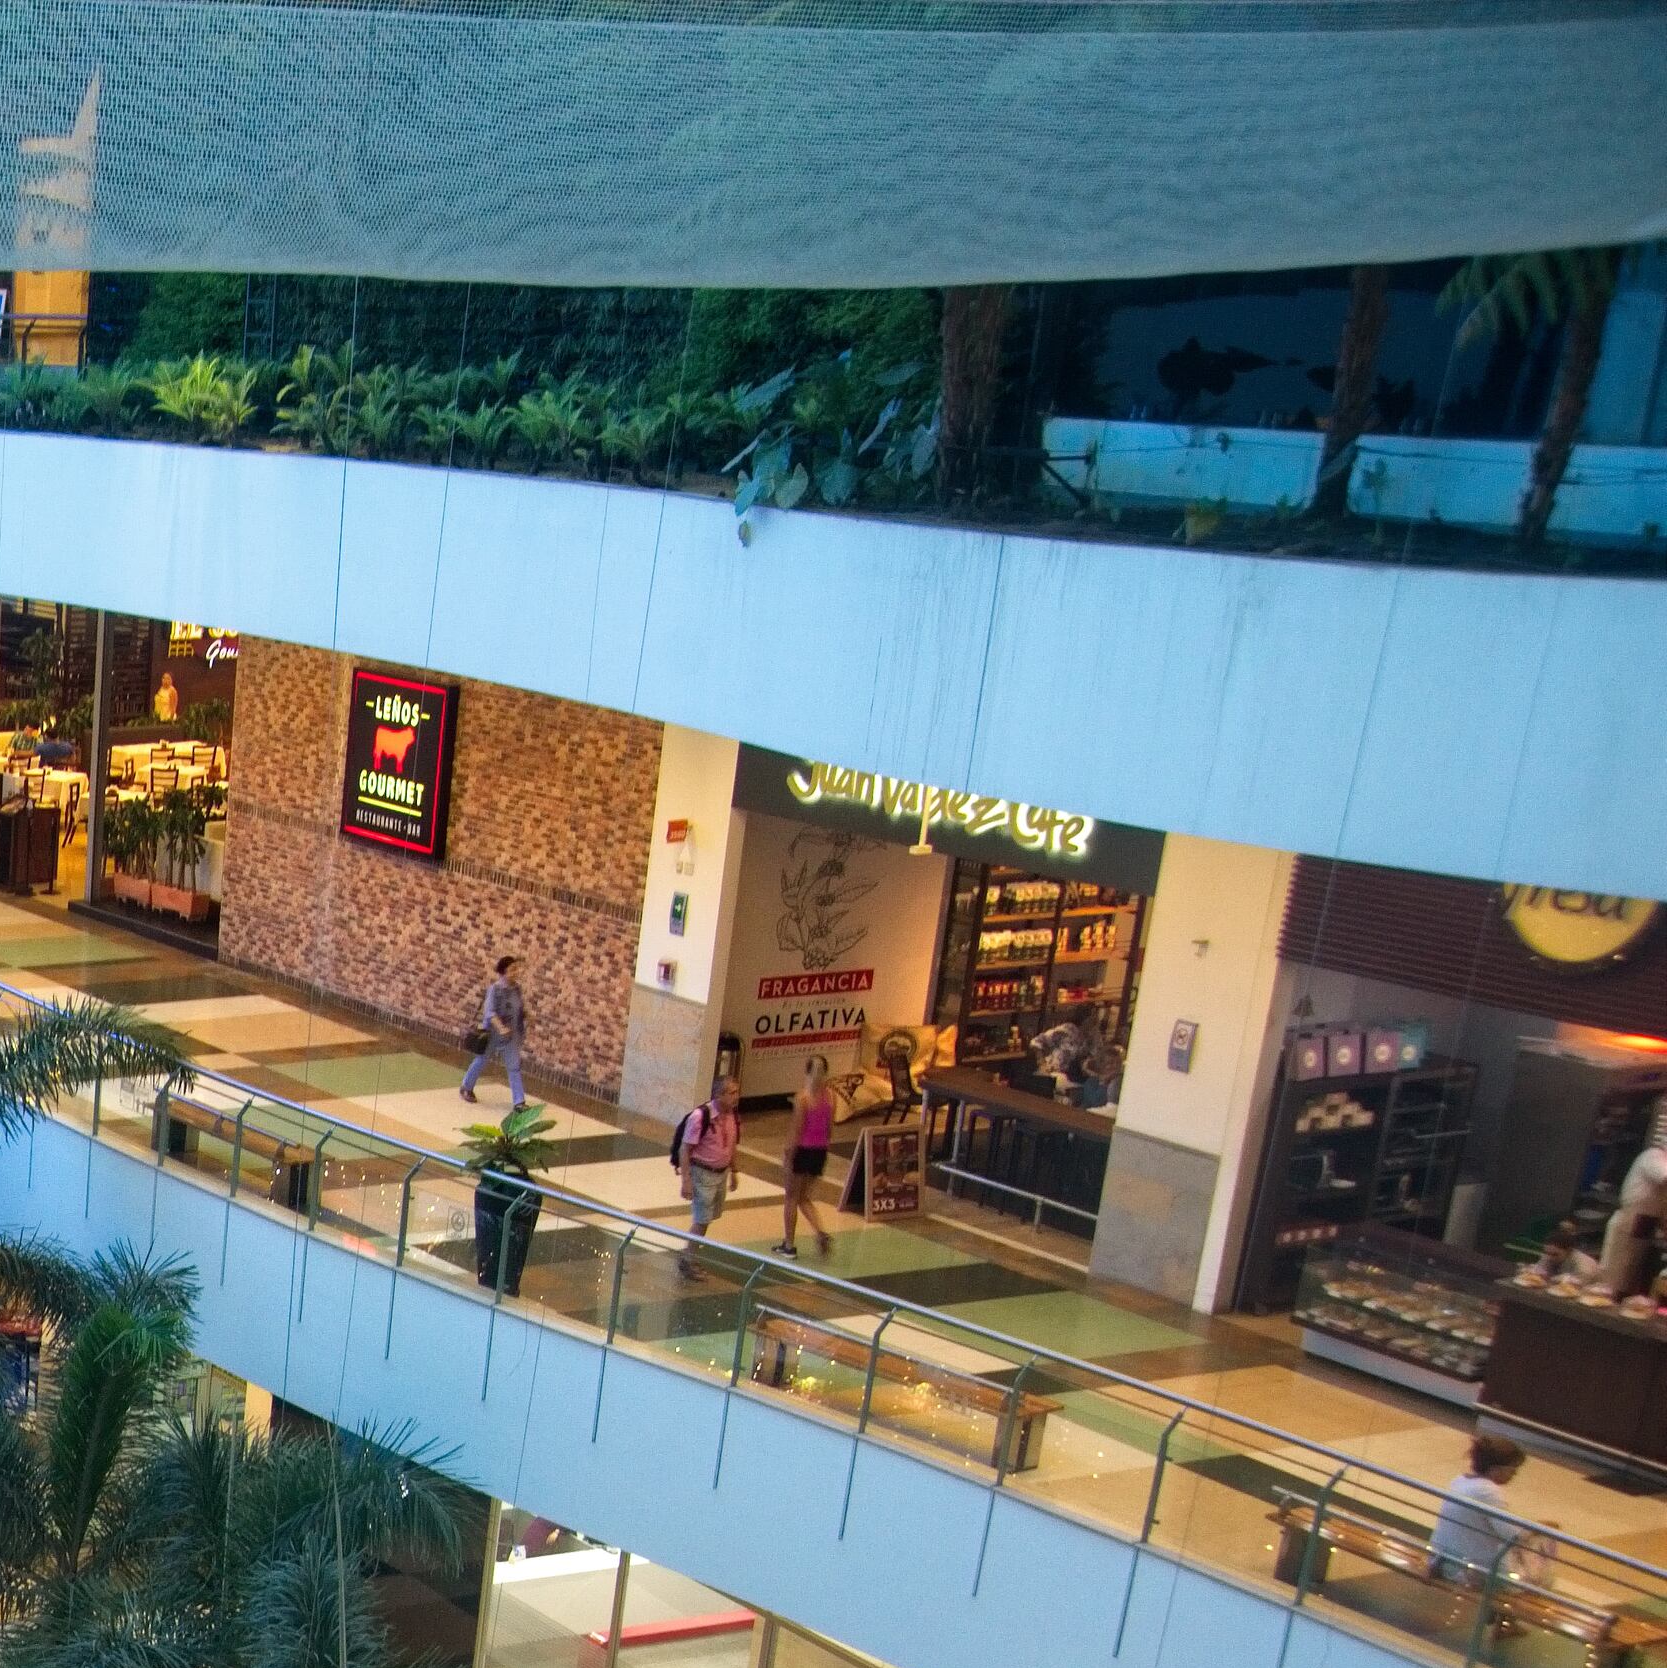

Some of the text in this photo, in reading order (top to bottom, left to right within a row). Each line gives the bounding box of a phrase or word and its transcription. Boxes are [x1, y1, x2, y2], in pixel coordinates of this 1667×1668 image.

[375, 693, 420, 728] LEÑOS
[358, 768, 425, 807] GOURMET
[355, 808, 402, 834] RESTAURANTE
[760, 973, 868, 998] FRAGANCIA
[755, 1007, 866, 1035] OLFATIVA
